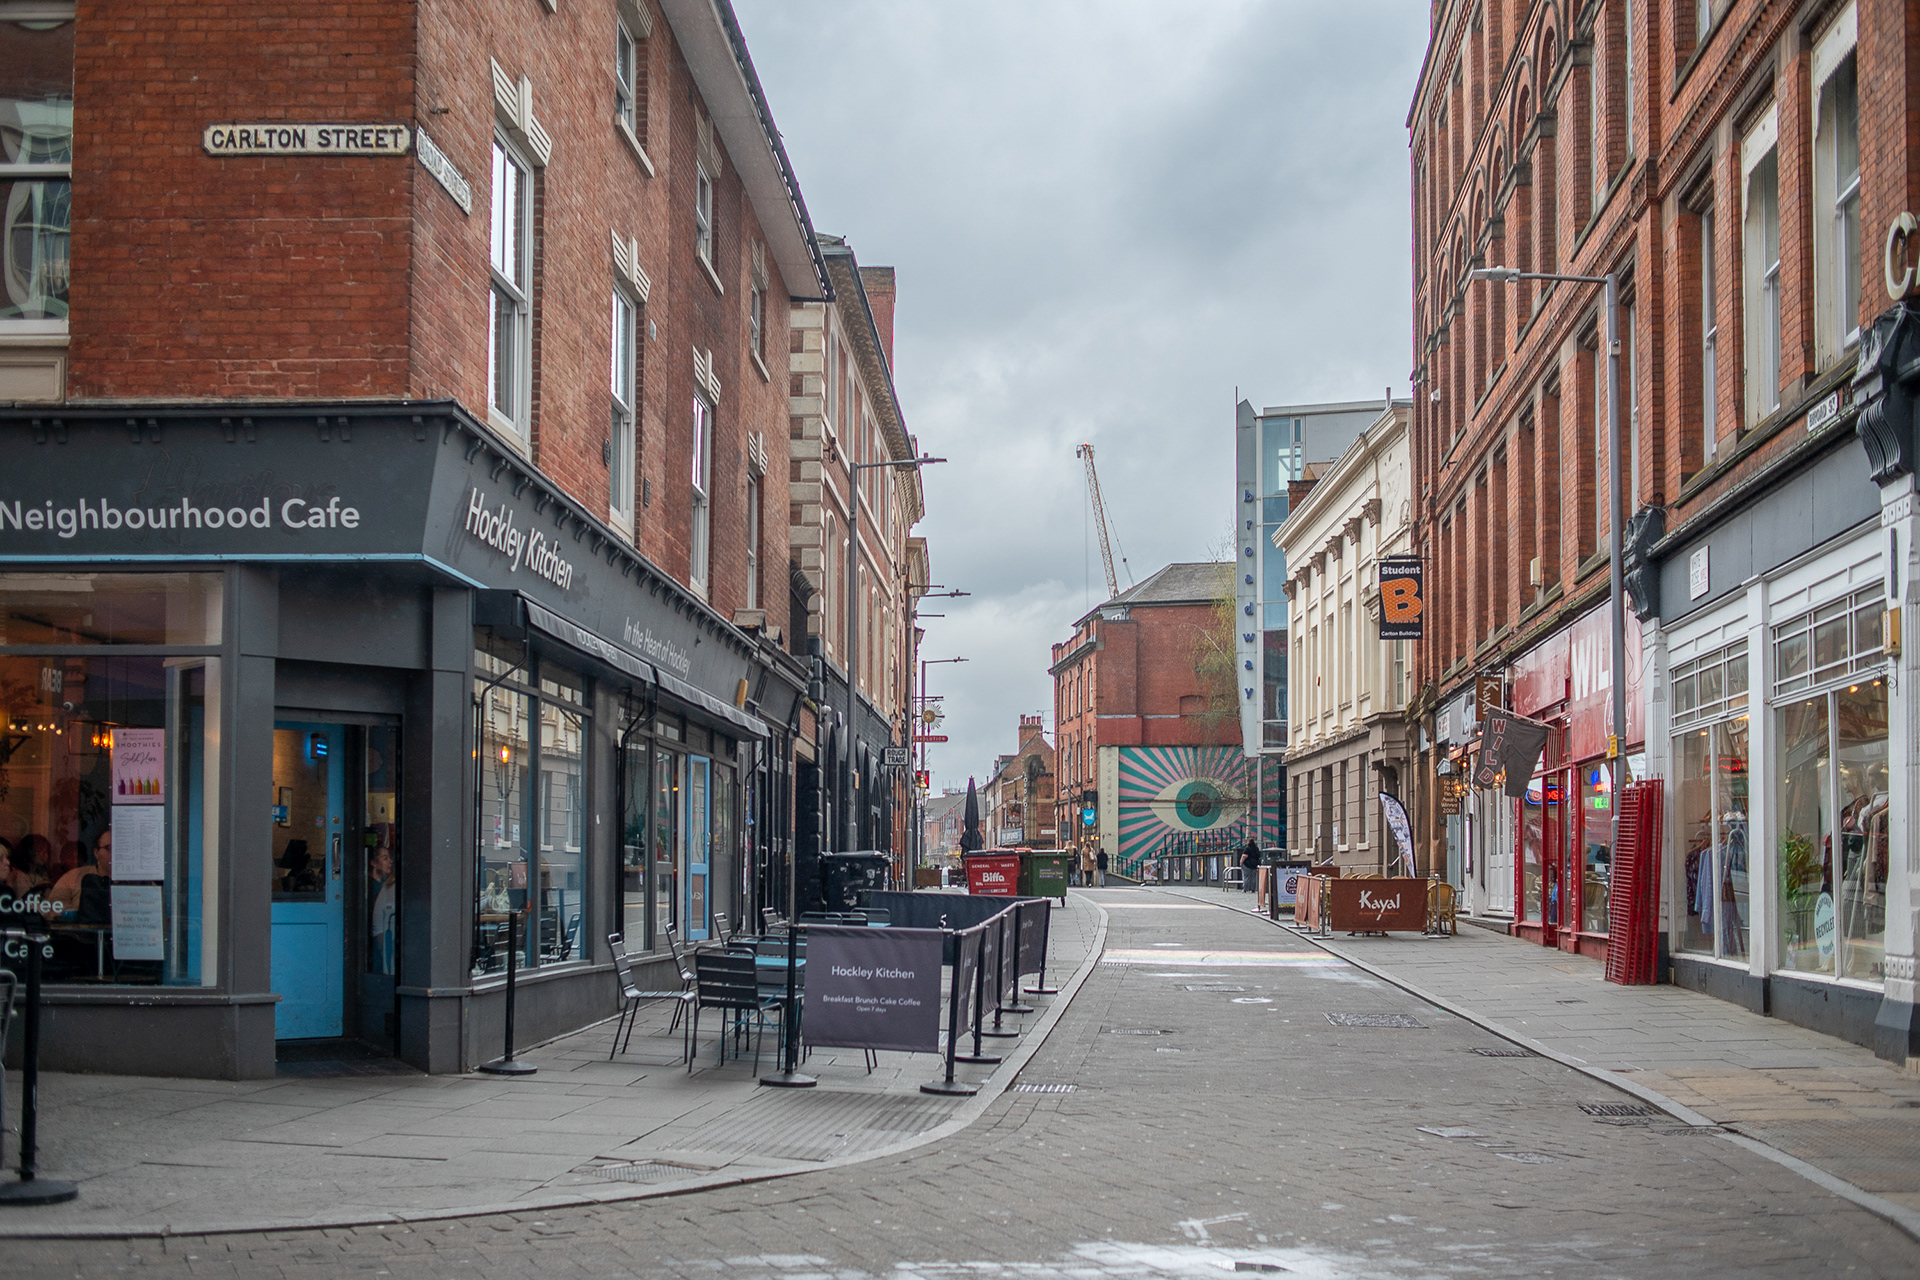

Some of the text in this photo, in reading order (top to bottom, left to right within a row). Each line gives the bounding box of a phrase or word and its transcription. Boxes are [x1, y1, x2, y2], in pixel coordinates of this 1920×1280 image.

[211, 129, 404, 149] CARLTON STREET
[0, 497, 361, 539] Neighbourhood Cafe
[465, 487, 573, 590] Hockley Kitchen
[1381, 566, 1421, 575] Student
[1243, 489, 1255, 699] broadway
[623, 616, 631, 642] In
[631, 621, 644, 648] the
[643, 628, 663, 663] Heart
[667, 640, 692, 681] Hockley
[1571, 621, 1613, 702] WIL
[887, 756, 906, 764] TRADE
[1478, 718, 1507, 785] WILD
[982, 872, 1005, 882] Biffa
[0, 894, 64, 913] Coffee
[1359, 890, 1400, 921] Kayal
[4, 939, 55, 958] Cae
[831, 966, 915, 980] Hockley Kitchen
[823, 995, 921, 1006] Breakfast Brunch Cake Coffee
